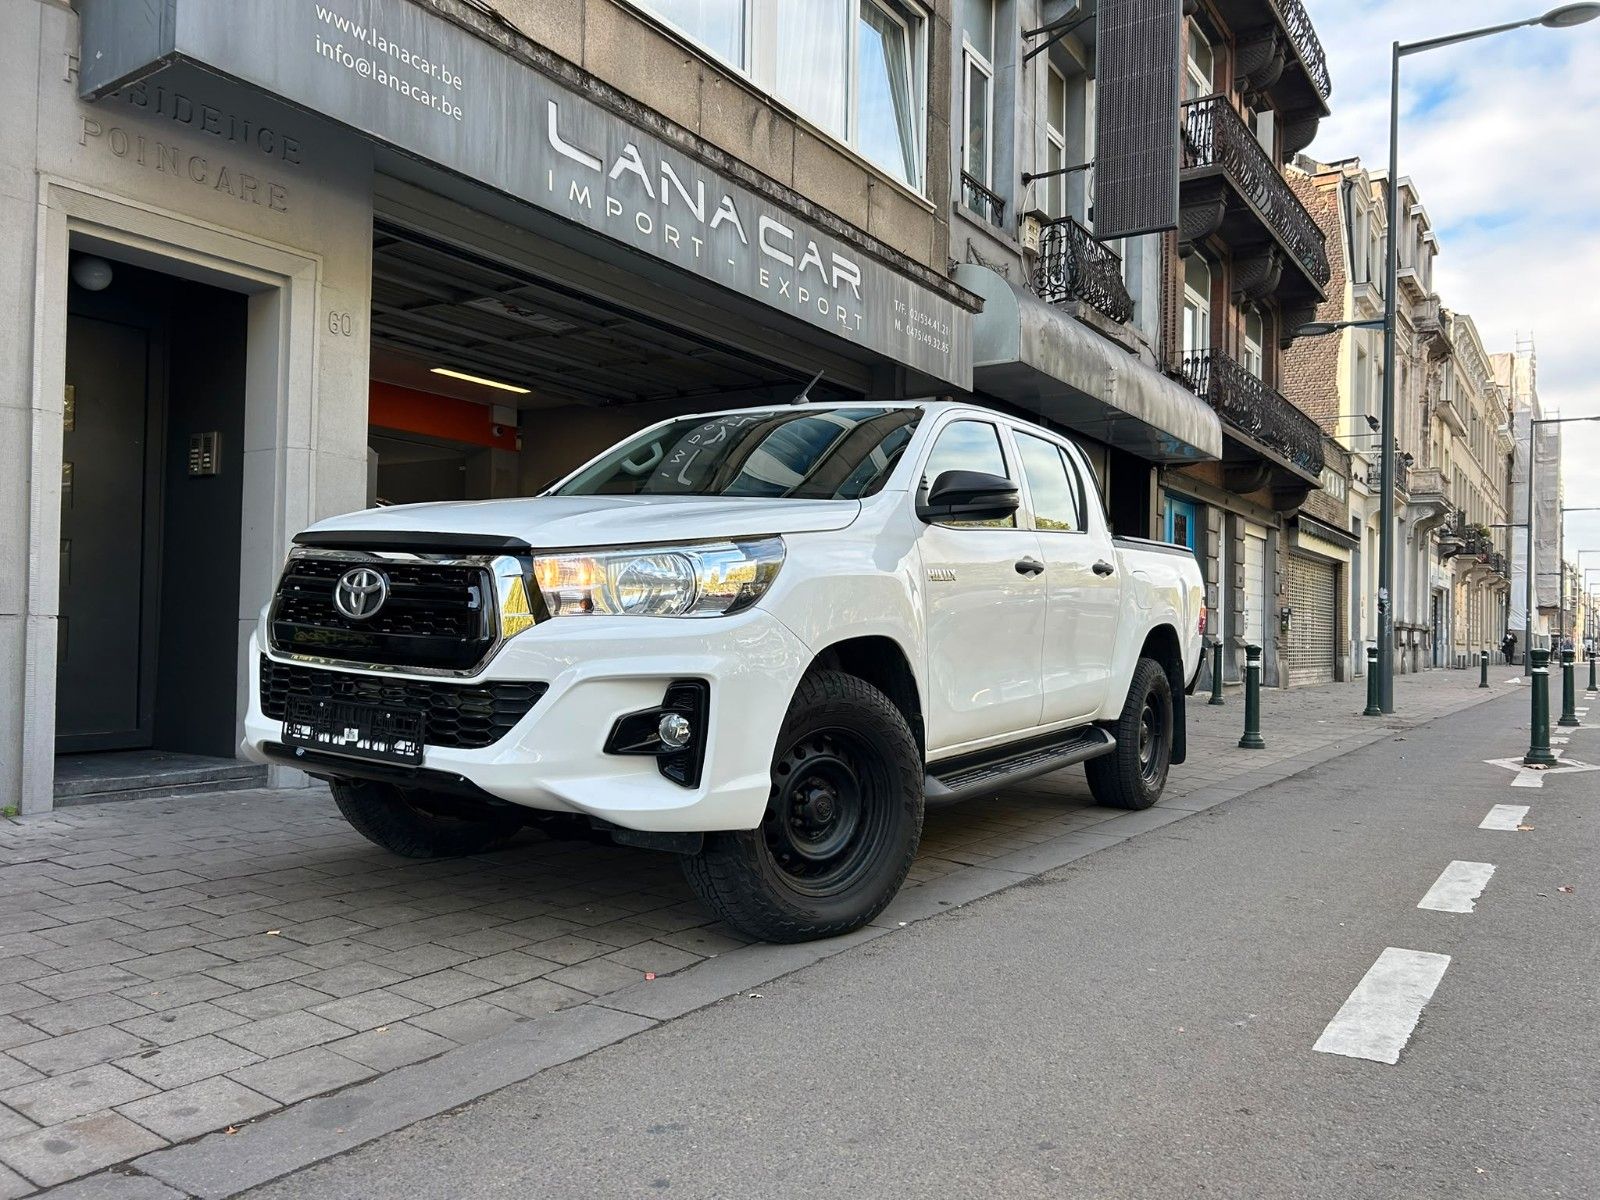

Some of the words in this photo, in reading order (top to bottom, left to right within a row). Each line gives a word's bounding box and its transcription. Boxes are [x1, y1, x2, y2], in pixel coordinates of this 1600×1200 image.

[315, 4, 463, 91] www.lanacar.be
[316, 34, 463, 121] info@lanacar.be
[78, 114, 288, 214] POINCARE
[547, 100, 863, 300] LANACAR
[548, 170, 704, 258] IMPORT
[759, 267, 863, 331] EXPORT
[328, 310, 351, 337] 60
